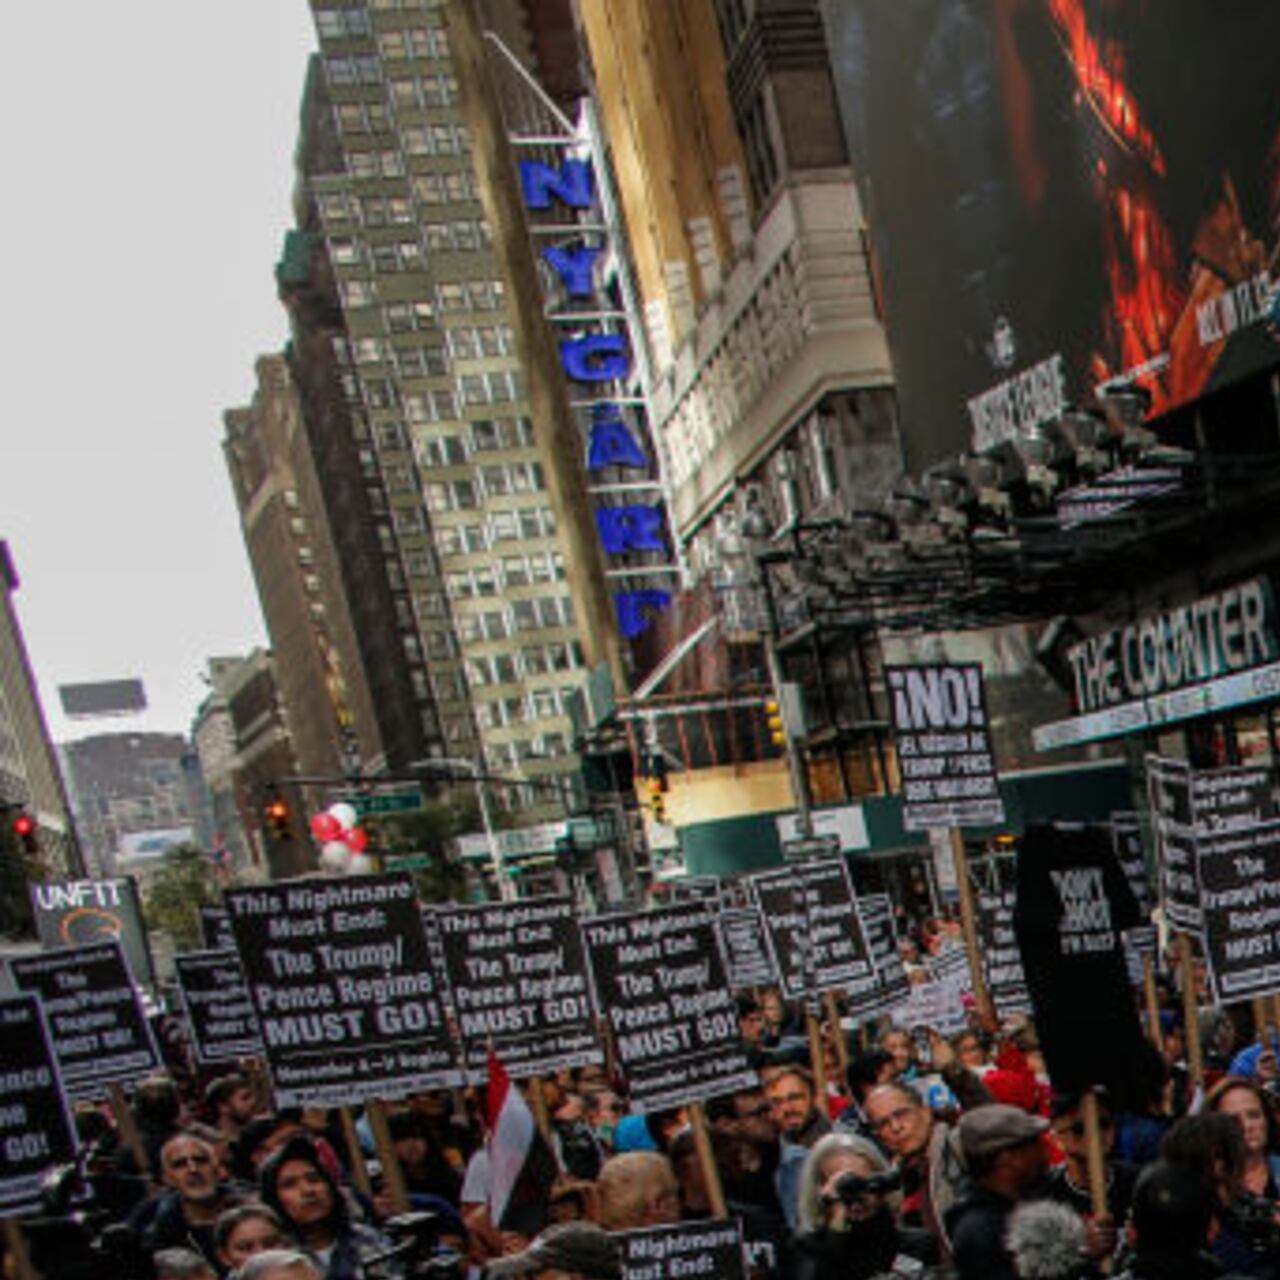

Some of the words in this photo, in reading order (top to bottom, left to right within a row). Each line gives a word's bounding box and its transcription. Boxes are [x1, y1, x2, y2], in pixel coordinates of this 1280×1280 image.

[1068, 635, 1120, 714] THE
[1122, 577, 1274, 699] COUNTER
[887, 667, 986, 730] ¡NO!
[36, 882, 121, 910] UNFIT
[229, 893, 282, 914] This
[287, 881, 411, 912] Nightmare
[268, 916, 326, 939] Must
[443, 911, 480, 932] This
[483, 904, 572, 927] Nightmare
[468, 930, 514, 951] Must
[588, 926, 628, 948] This
[266, 948, 315, 977] The
[317, 934, 404, 973] Trump/
[465, 955, 502, 979] The
[617, 942, 662, 964] Must
[256, 983, 334, 1012] Pence
[336, 971, 434, 1003] Regime
[456, 983, 516, 1007] Pence
[616, 973, 654, 998] The
[264, 1008, 367, 1047] MUST
[375, 1000, 442, 1035] GO!
[461, 1005, 539, 1037] MUST
[541, 995, 590, 1023] GO!
[610, 1005, 670, 1031] Pence
[617, 1029, 692, 1064] MUST
[696, 1011, 740, 1041] GO!
[5, 1133, 50, 1161] GO!
